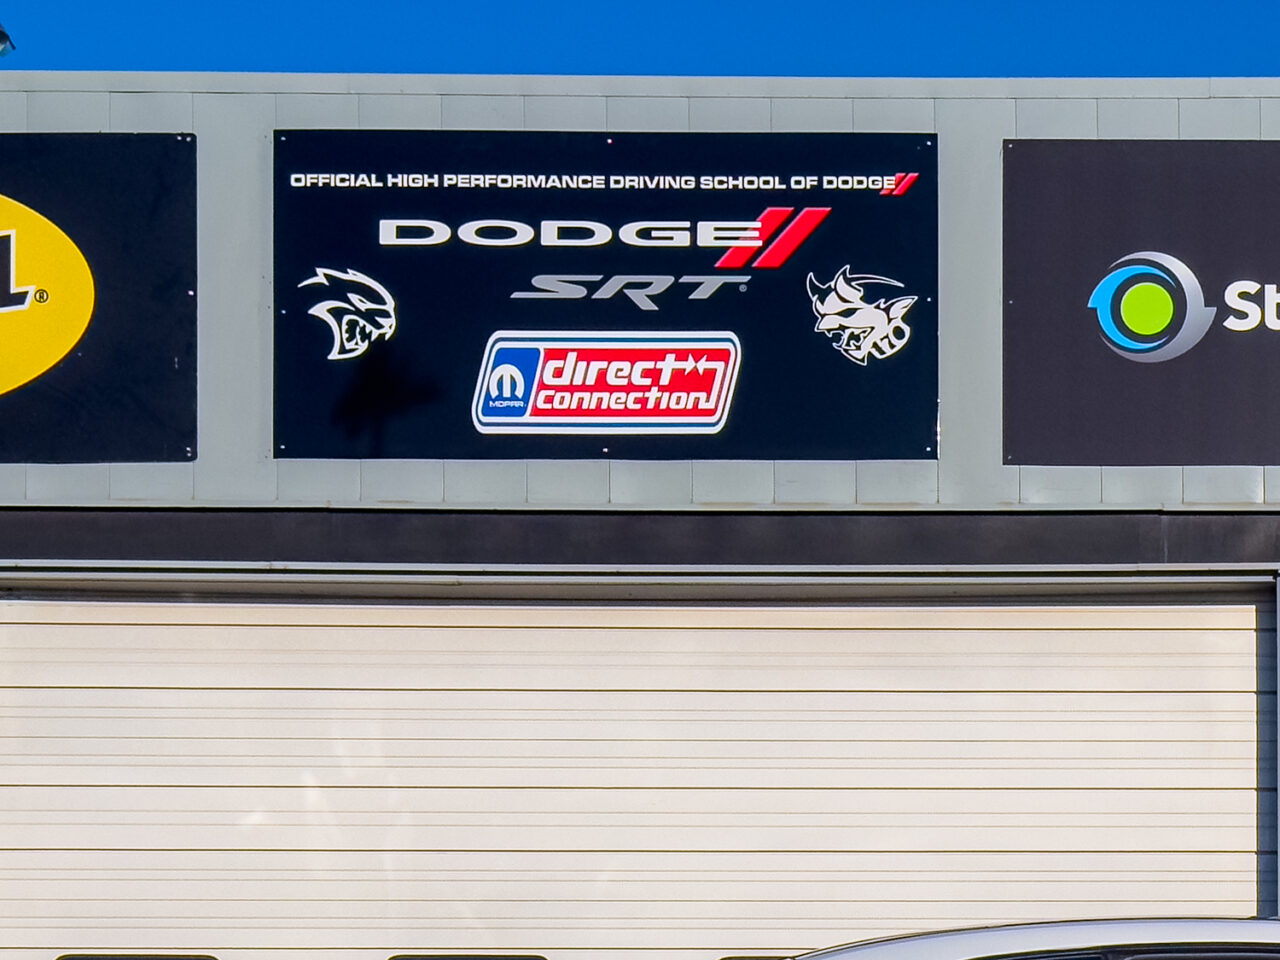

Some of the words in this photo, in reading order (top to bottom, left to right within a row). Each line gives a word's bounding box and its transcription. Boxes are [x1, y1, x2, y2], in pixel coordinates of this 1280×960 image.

[290, 173, 383, 188] OFFICIAL
[387, 173, 439, 188] HIGH
[443, 174, 606, 189] PERFORMANCE
[609, 175, 696, 190] DRIVING
[699, 175, 786, 190] SCHOOL
[790, 175, 819, 190] OF
[822, 175, 896, 190] DODGE
[379, 219, 763, 247] DODGE
[510, 274, 751, 311] SRT
[542, 352, 681, 386] direct
[536, 387, 719, 410] connection
